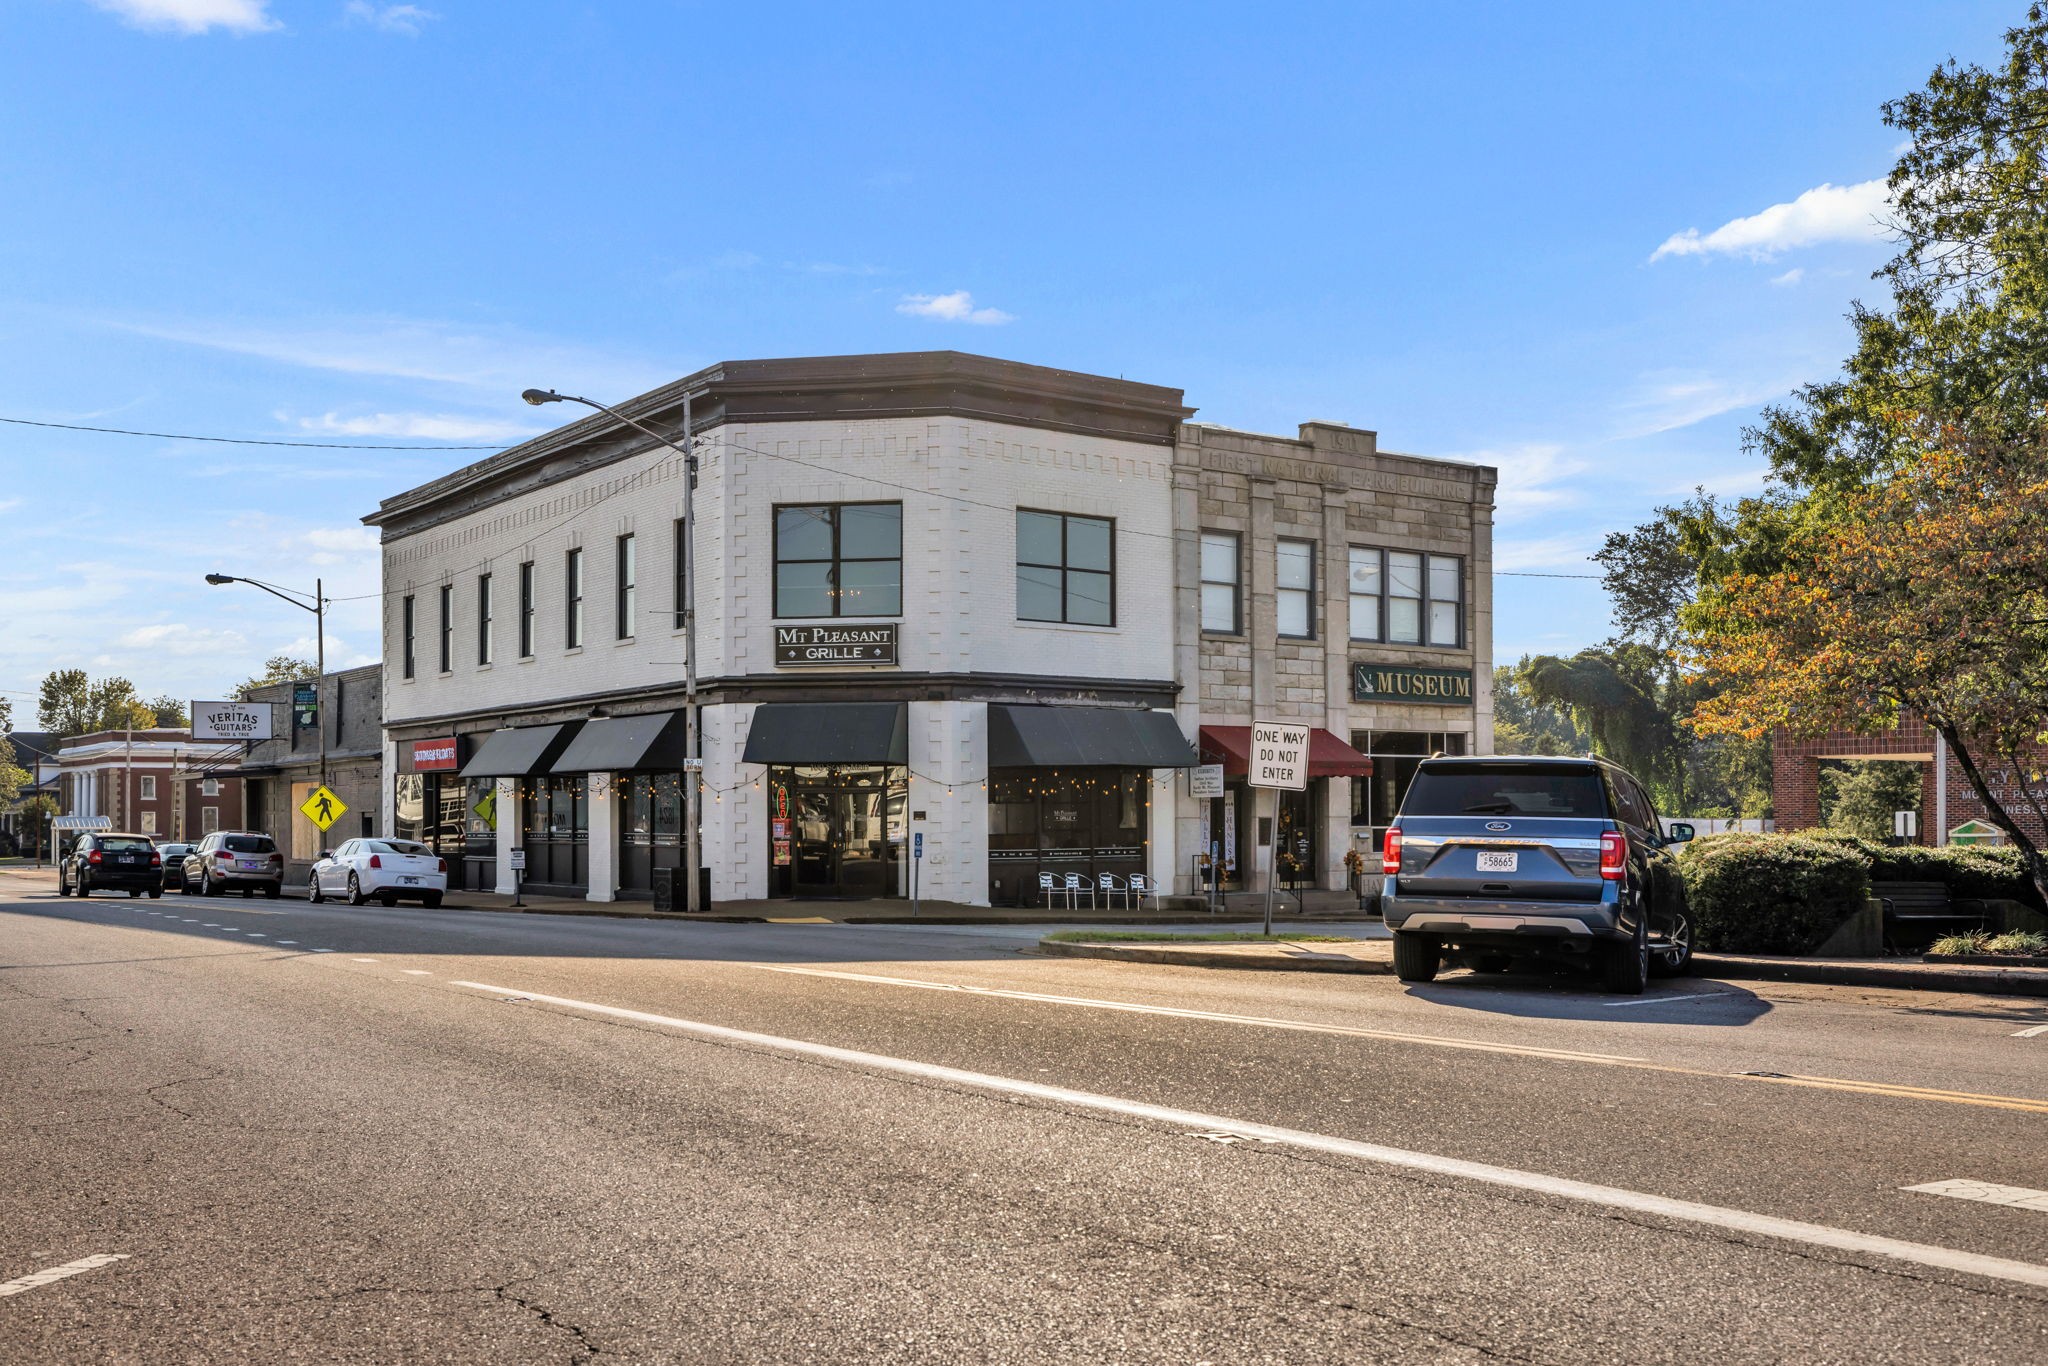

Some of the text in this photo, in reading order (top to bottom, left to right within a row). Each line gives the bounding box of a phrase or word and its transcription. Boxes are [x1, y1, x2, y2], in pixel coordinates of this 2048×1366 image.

[1209, 451, 1467, 500] FIRST NATIONAL BANK BUILDING
[805, 646, 864, 659] GRILLE
[1376, 672, 1471, 697] MUSEUM
[207, 712, 258, 725] VERITAS
[213, 723, 253, 731] GUITARS
[1255, 729, 1306, 745] ONE WAY
[1260, 748, 1298, 763] DO NOT
[1262, 766, 1294, 781] ENTER
[1961, 790, 2004, 799] MONT
[1488, 856, 1513, 867] 58665
